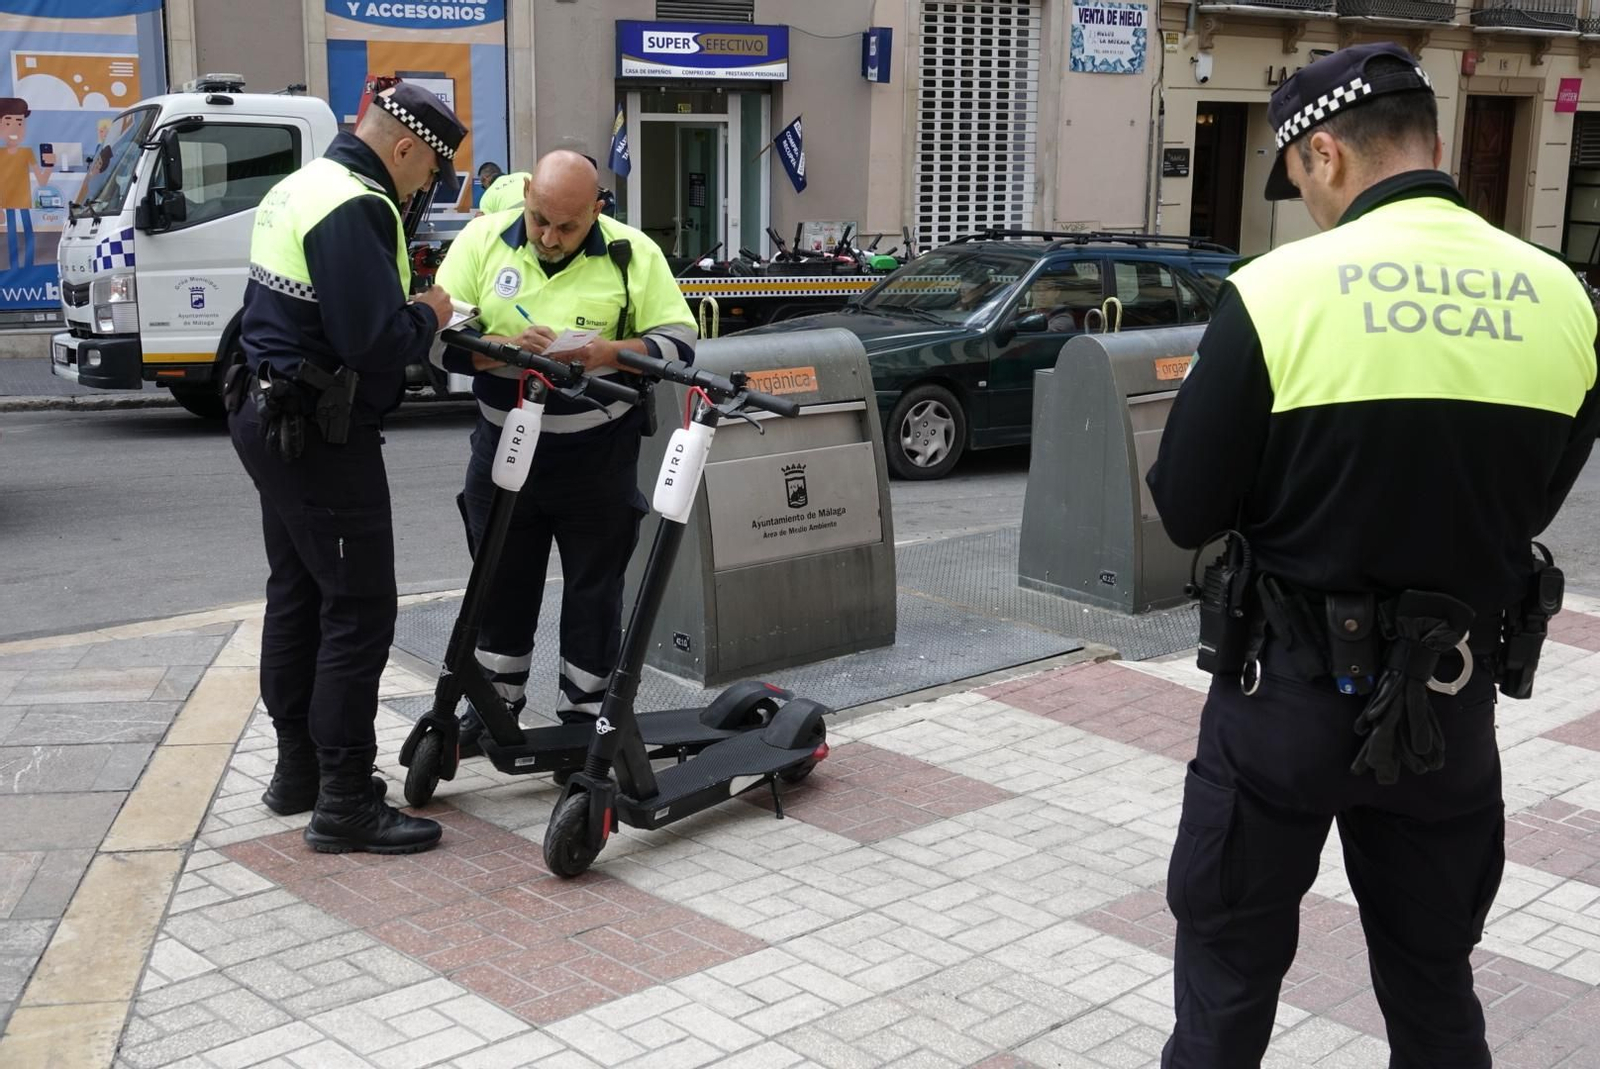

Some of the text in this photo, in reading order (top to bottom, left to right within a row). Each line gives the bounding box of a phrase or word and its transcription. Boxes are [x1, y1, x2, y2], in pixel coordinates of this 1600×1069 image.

[347, 2, 486, 21] Y ACCESORIOS
[1078, 7, 1143, 27] VENTA DE HIELO
[647, 37, 764, 52] SUPER EFECTIVO
[1338, 261, 1540, 304] POLICIA
[178, 312, 219, 320] Ayuntamiento
[1363, 300, 1524, 342] LOCAL
[749, 371, 811, 393] orgánica
[506, 424, 526, 464] BIRD
[664, 443, 684, 487] BIRD
[752, 506, 846, 529] Ayuntamiento de Málaga
[779, 526, 787, 536] de
[788, 524, 808, 535] Medio
[809, 520, 837, 531] Ambiente
